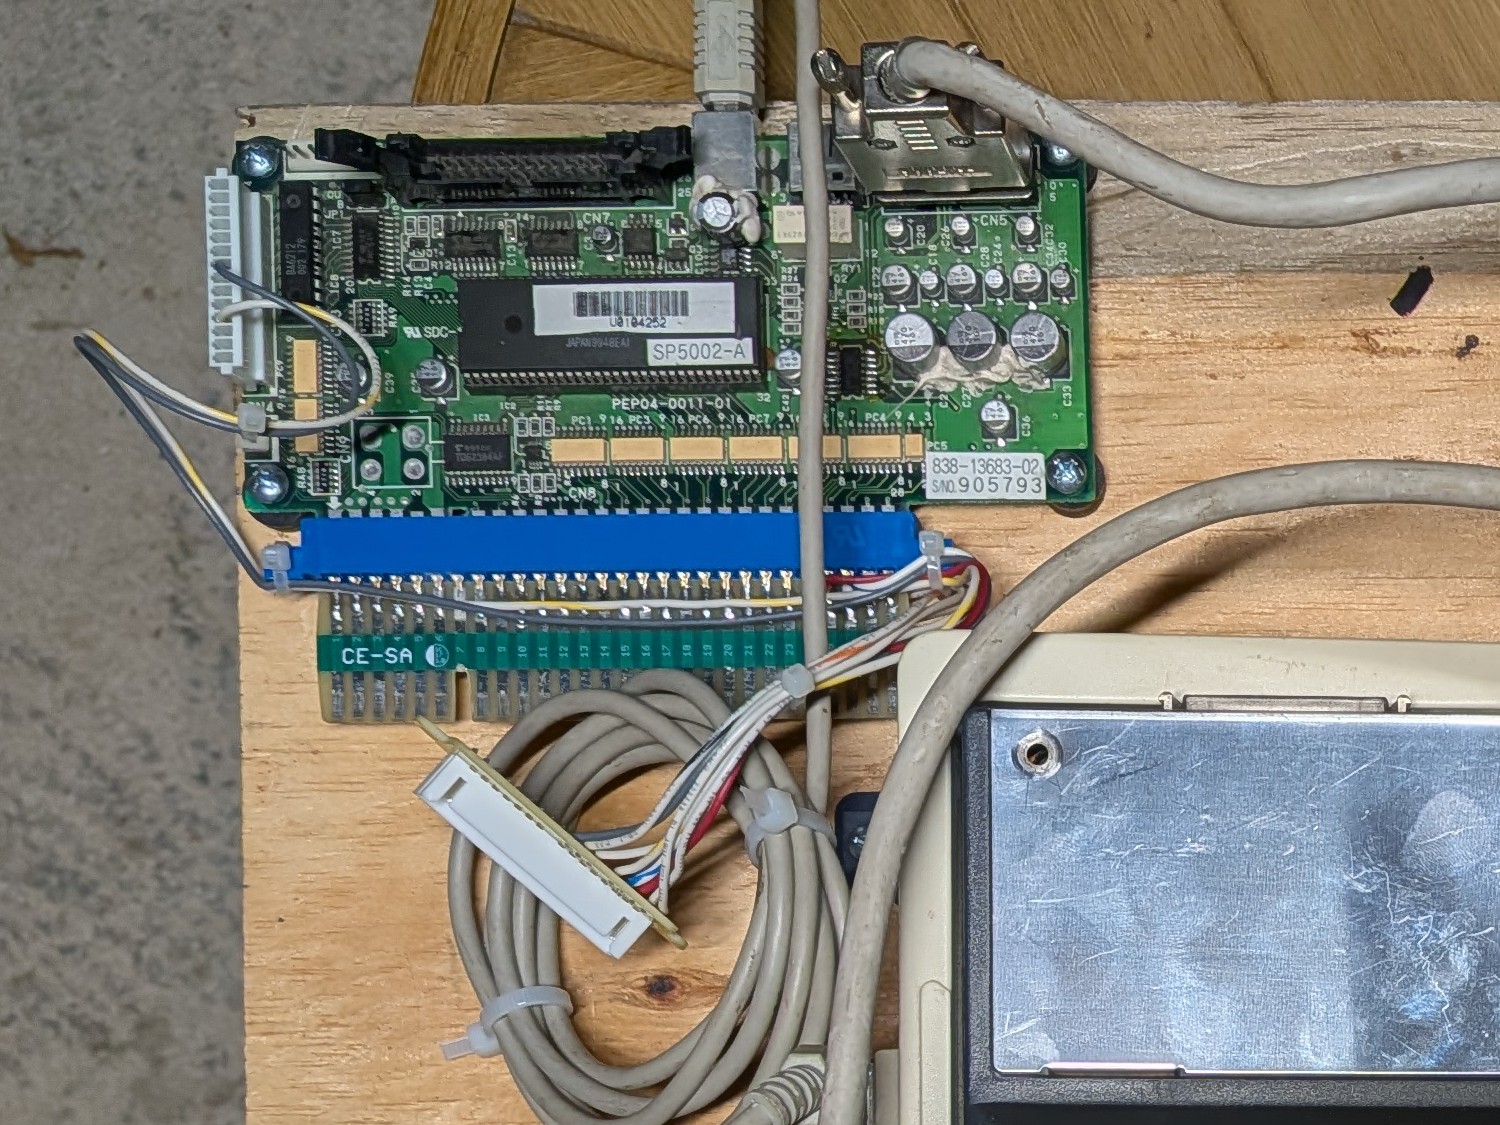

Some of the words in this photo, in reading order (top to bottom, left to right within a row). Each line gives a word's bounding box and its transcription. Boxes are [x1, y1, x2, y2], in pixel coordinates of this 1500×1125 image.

[582, 212, 610, 224] CN7
[979, 215, 1008, 227] CN5
[916, 224, 926, 246] C20
[928, 244, 938, 265] C18
[980, 246, 990, 267] C28
[653, 342, 746, 361] SP5002-A
[385, 372, 395, 394] C39
[1062, 385, 1072, 407] C33
[571, 415, 591, 425] PC1
[628, 415, 650, 425] PC3
[688, 414, 710, 424] PC6
[749, 413, 770, 424] PC7
[1021, 415, 1032, 437] C36
[932, 458, 1040, 475] 838-13683-02
[568, 487, 597, 499] CN8
[958, 476, 1042, 494] 905793
[341, 647, 413, 665] CE-SA
